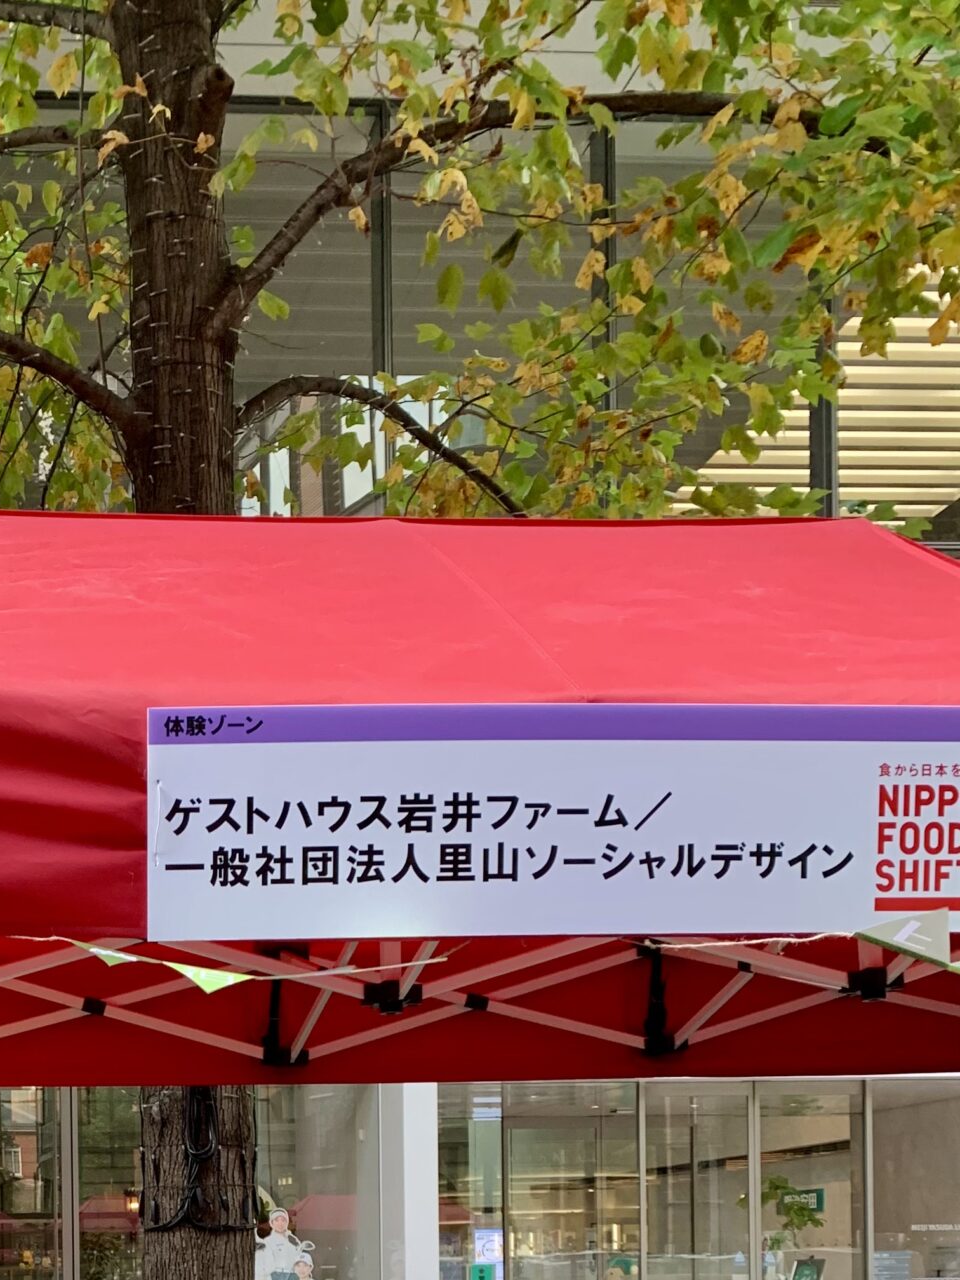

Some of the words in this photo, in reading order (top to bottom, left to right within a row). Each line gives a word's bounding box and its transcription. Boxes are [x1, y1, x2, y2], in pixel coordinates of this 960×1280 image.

[163, 714, 264, 737] 体験ゾーン
[163, 791, 673, 835] ゲストハウス岩井ファーム／
[164, 842, 854, 888] 一般社団法人里山ソーシャルデザイン
[874, 858, 960, 893] SHIF
